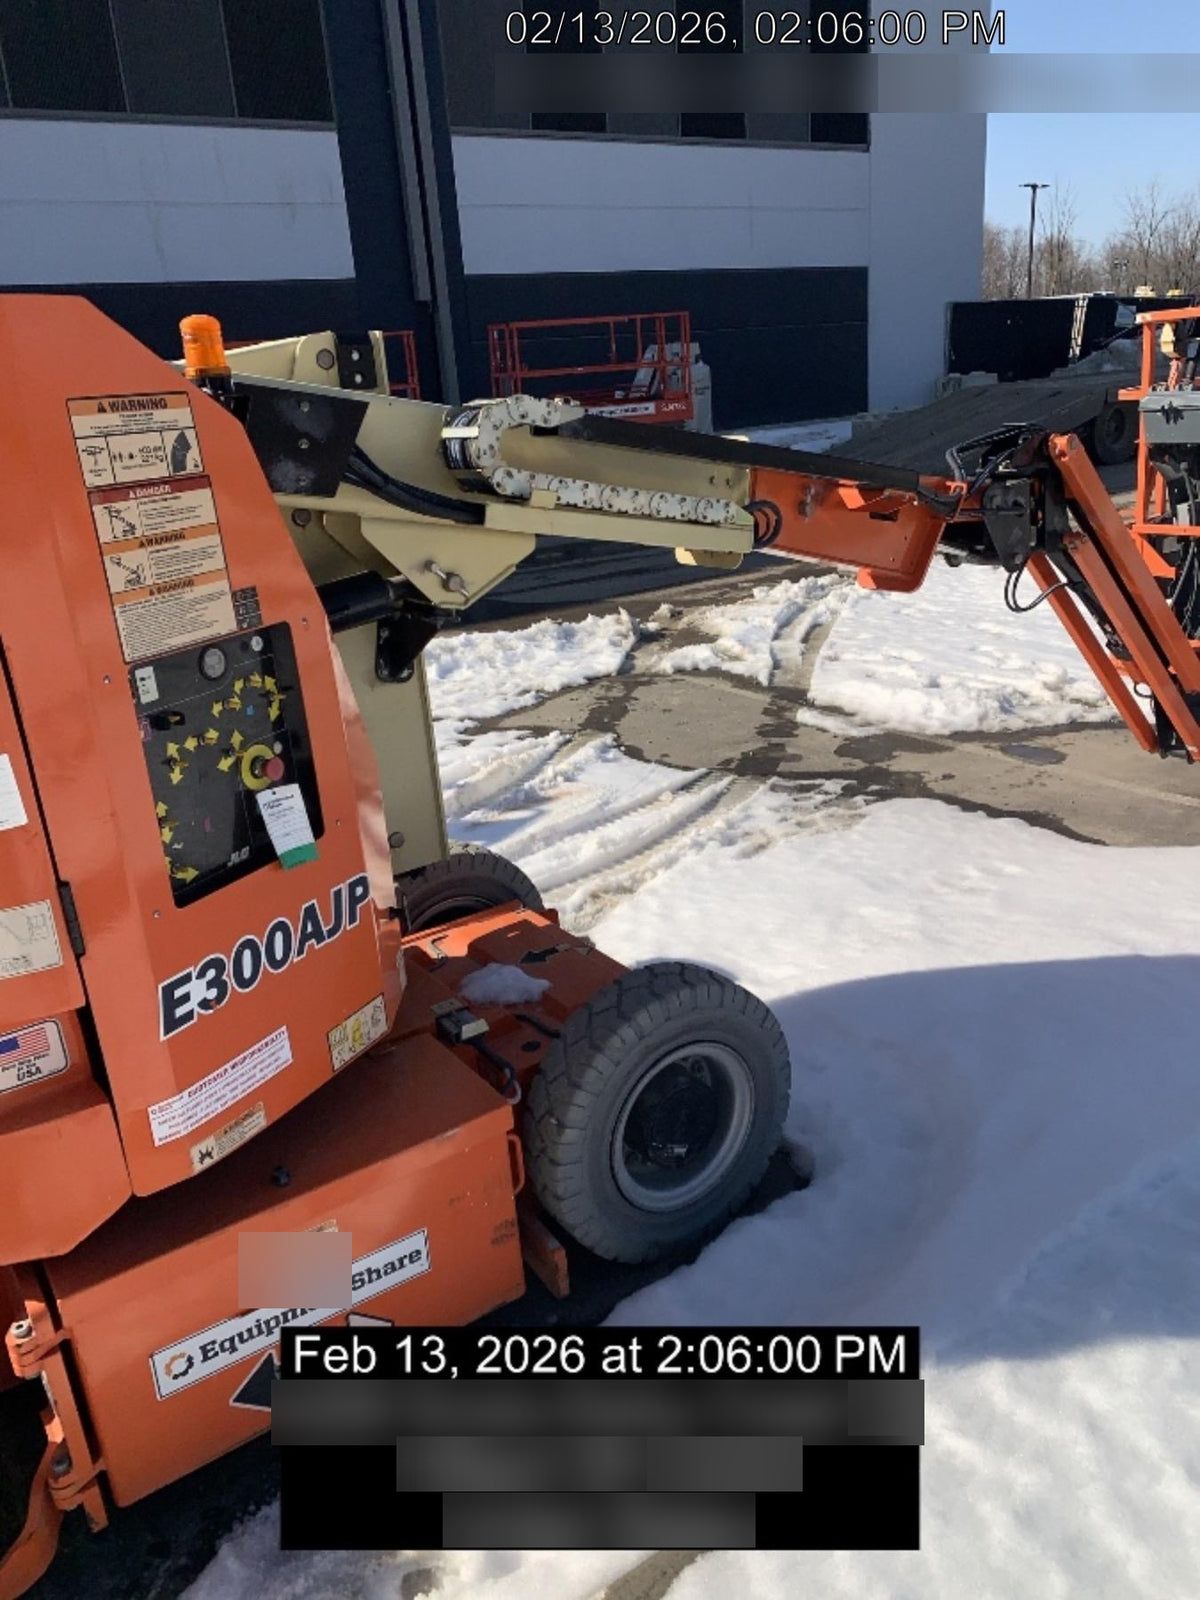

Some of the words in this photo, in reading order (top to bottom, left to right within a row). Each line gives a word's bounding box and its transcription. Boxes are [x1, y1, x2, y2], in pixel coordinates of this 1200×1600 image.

[108, 398, 168, 413] WARNING
[159, 872, 372, 1042] E300AJP
[16, 1065, 42, 1082] USA
